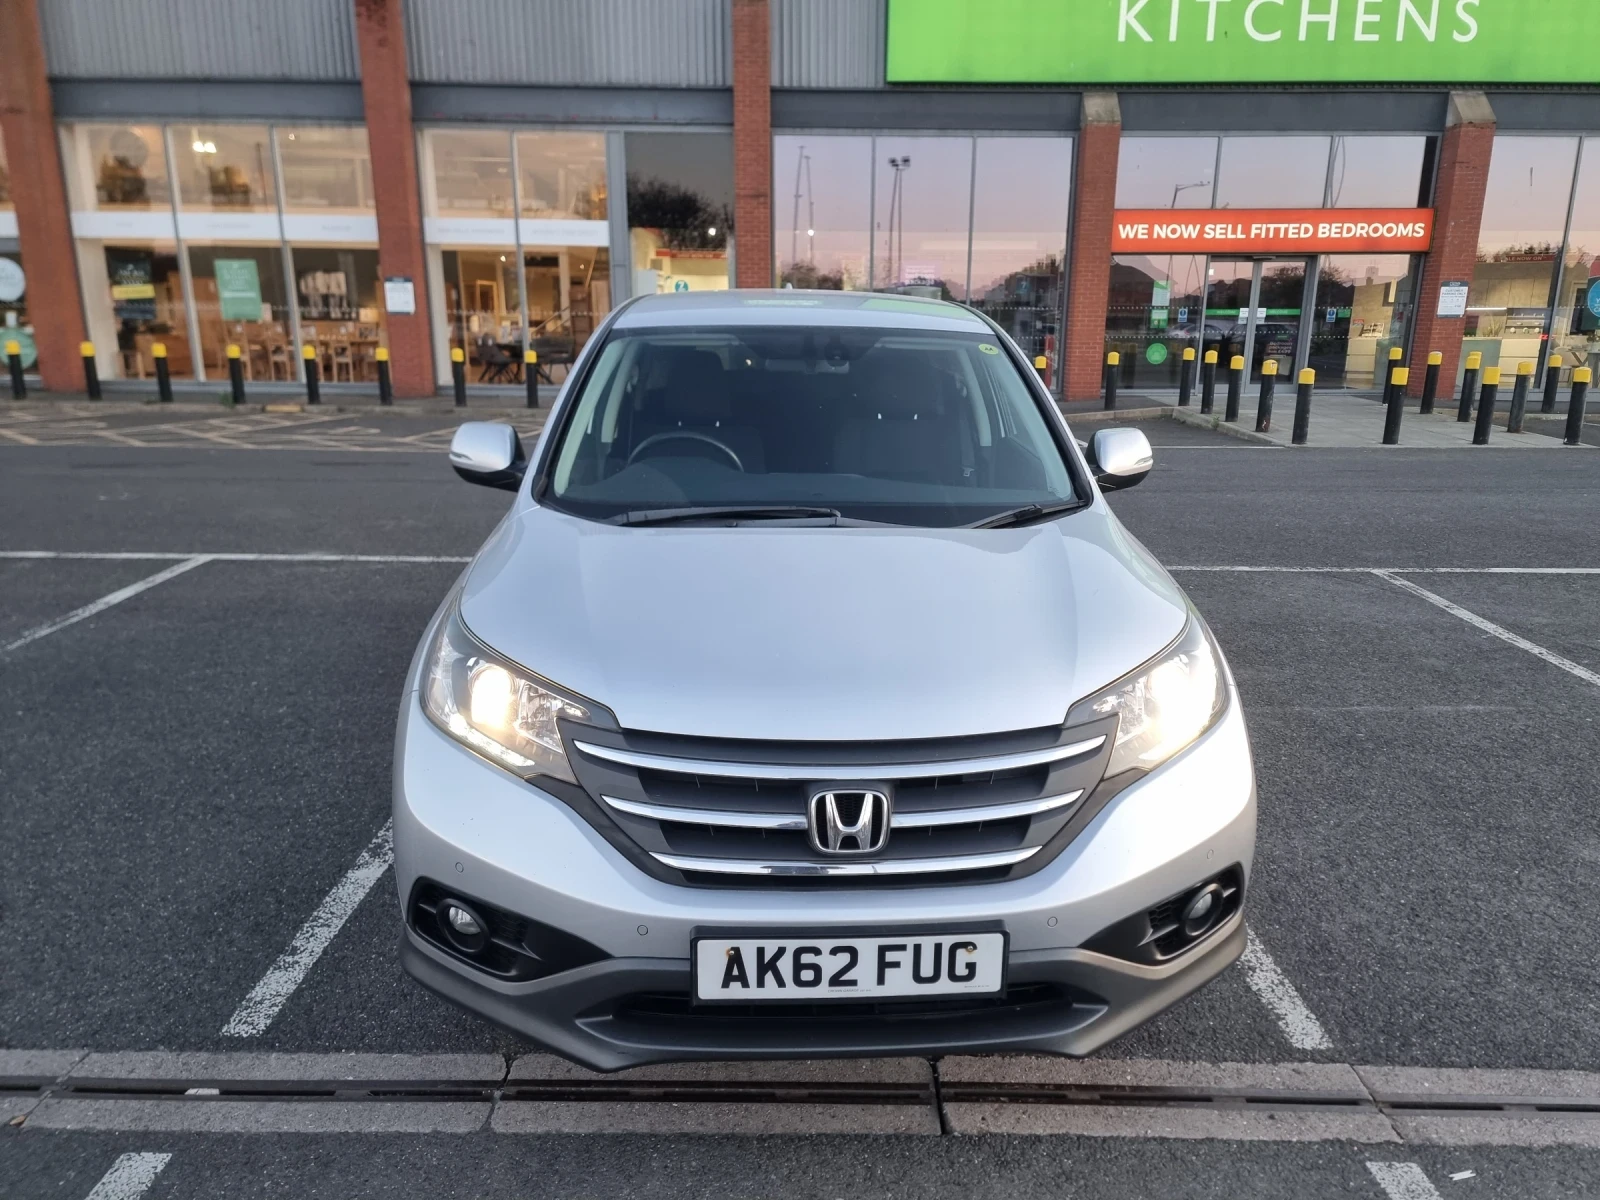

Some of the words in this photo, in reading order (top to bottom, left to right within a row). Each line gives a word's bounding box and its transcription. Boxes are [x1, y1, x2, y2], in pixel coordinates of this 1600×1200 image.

[1117, 0, 1480, 42] KITCHENS
[1118, 223, 1149, 239] WE
[1153, 223, 1200, 239] NOW
[1203, 223, 1246, 239] SELL
[1250, 222, 1314, 239] FITTED
[1317, 222, 1425, 238] BEDROOMS
[720, 945, 859, 989] AK62
[876, 941, 978, 986] FUG
